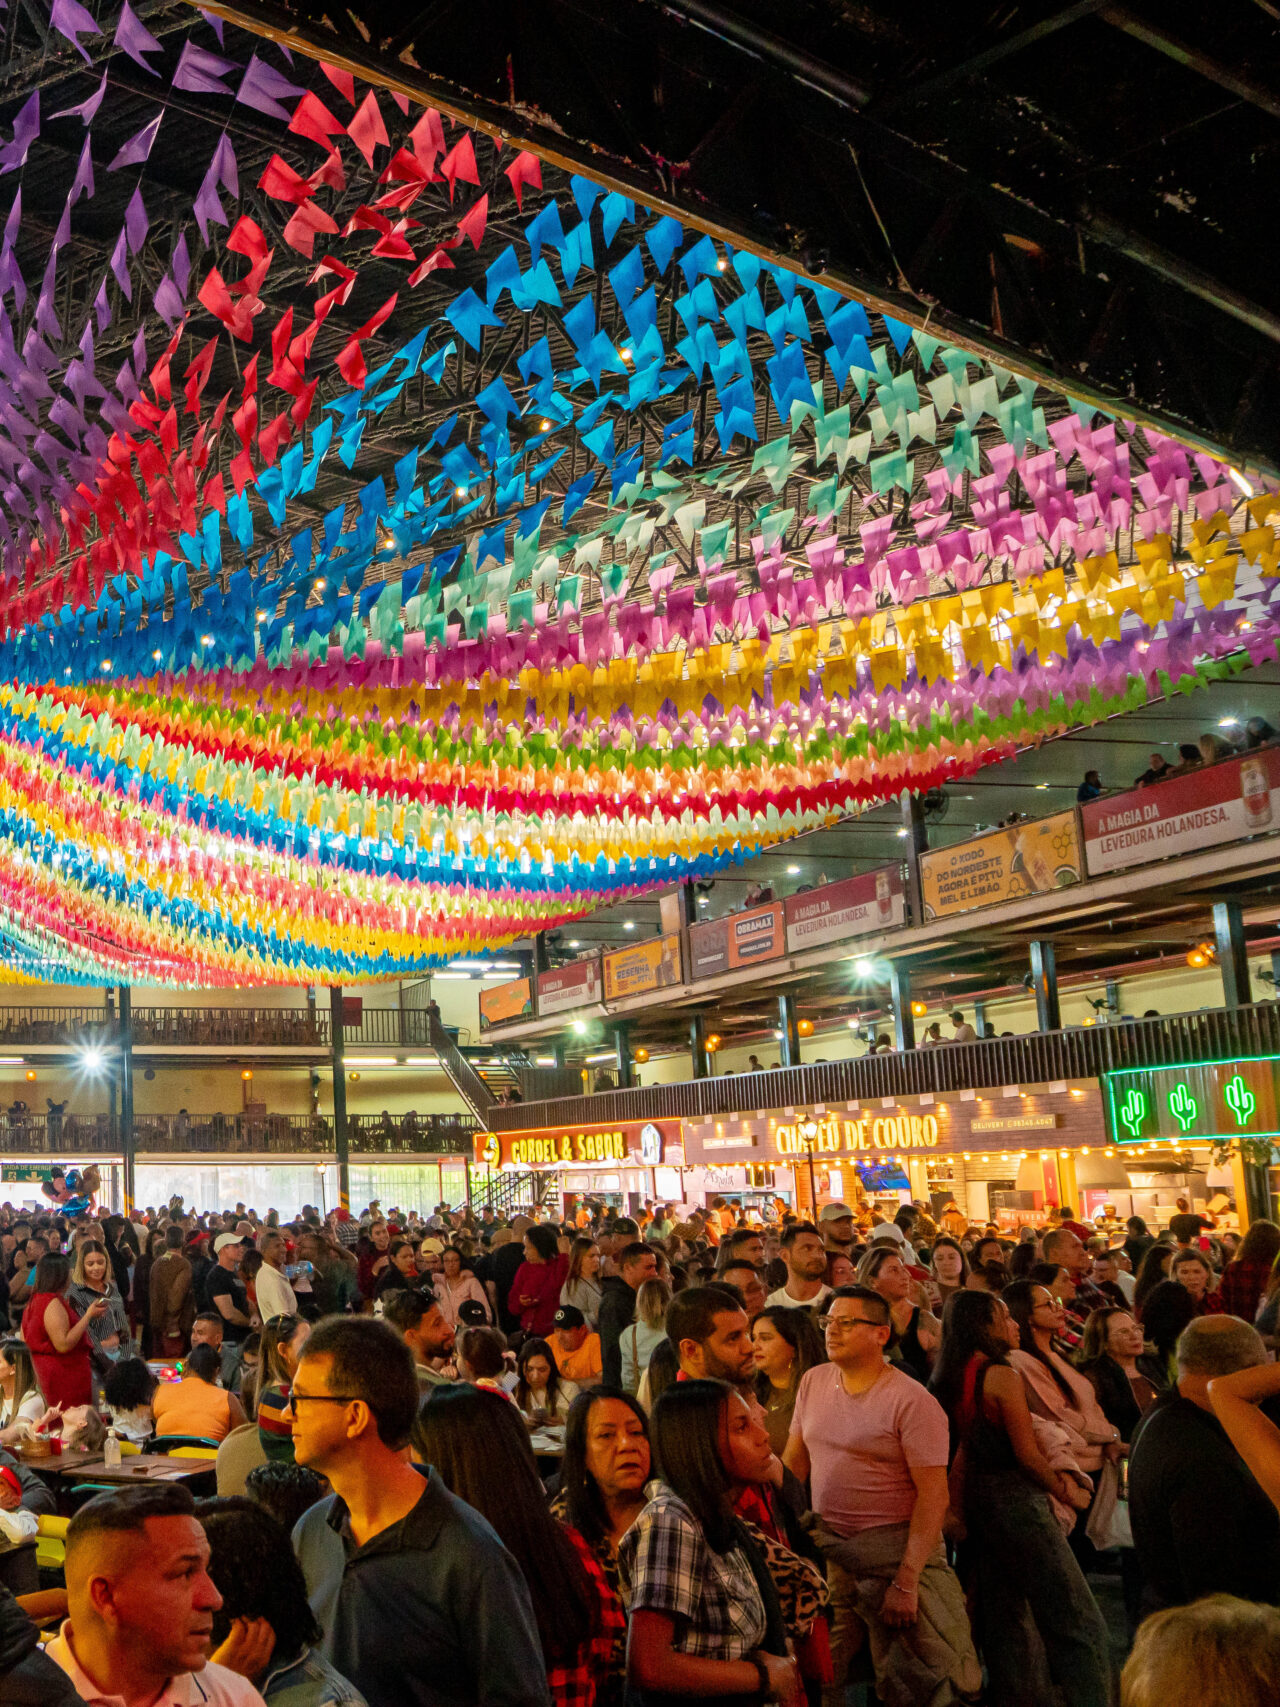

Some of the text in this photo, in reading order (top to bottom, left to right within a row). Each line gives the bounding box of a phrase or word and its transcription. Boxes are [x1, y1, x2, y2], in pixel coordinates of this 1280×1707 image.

[1099, 803, 1160, 834] A MAGIA DA
[1101, 807, 1230, 854] LEVEDURA HOLANDESA.
[937, 855, 1002, 882] DO NORDESTE
[938, 878, 969, 894] AGORA
[940, 882, 1000, 906] MEL E LIMÃO
[800, 903, 820, 919] MAGIA
[821, 900, 830, 913] DA
[738, 917, 771, 934] OBRAMAX
[795, 918, 827, 936] LEVEDURA
[775, 1114, 938, 1155] CHAÉU DE COURO
[972, 1120, 1004, 1130] DELIVERY
[511, 1132, 624, 1164] CORDEL & SABOR
